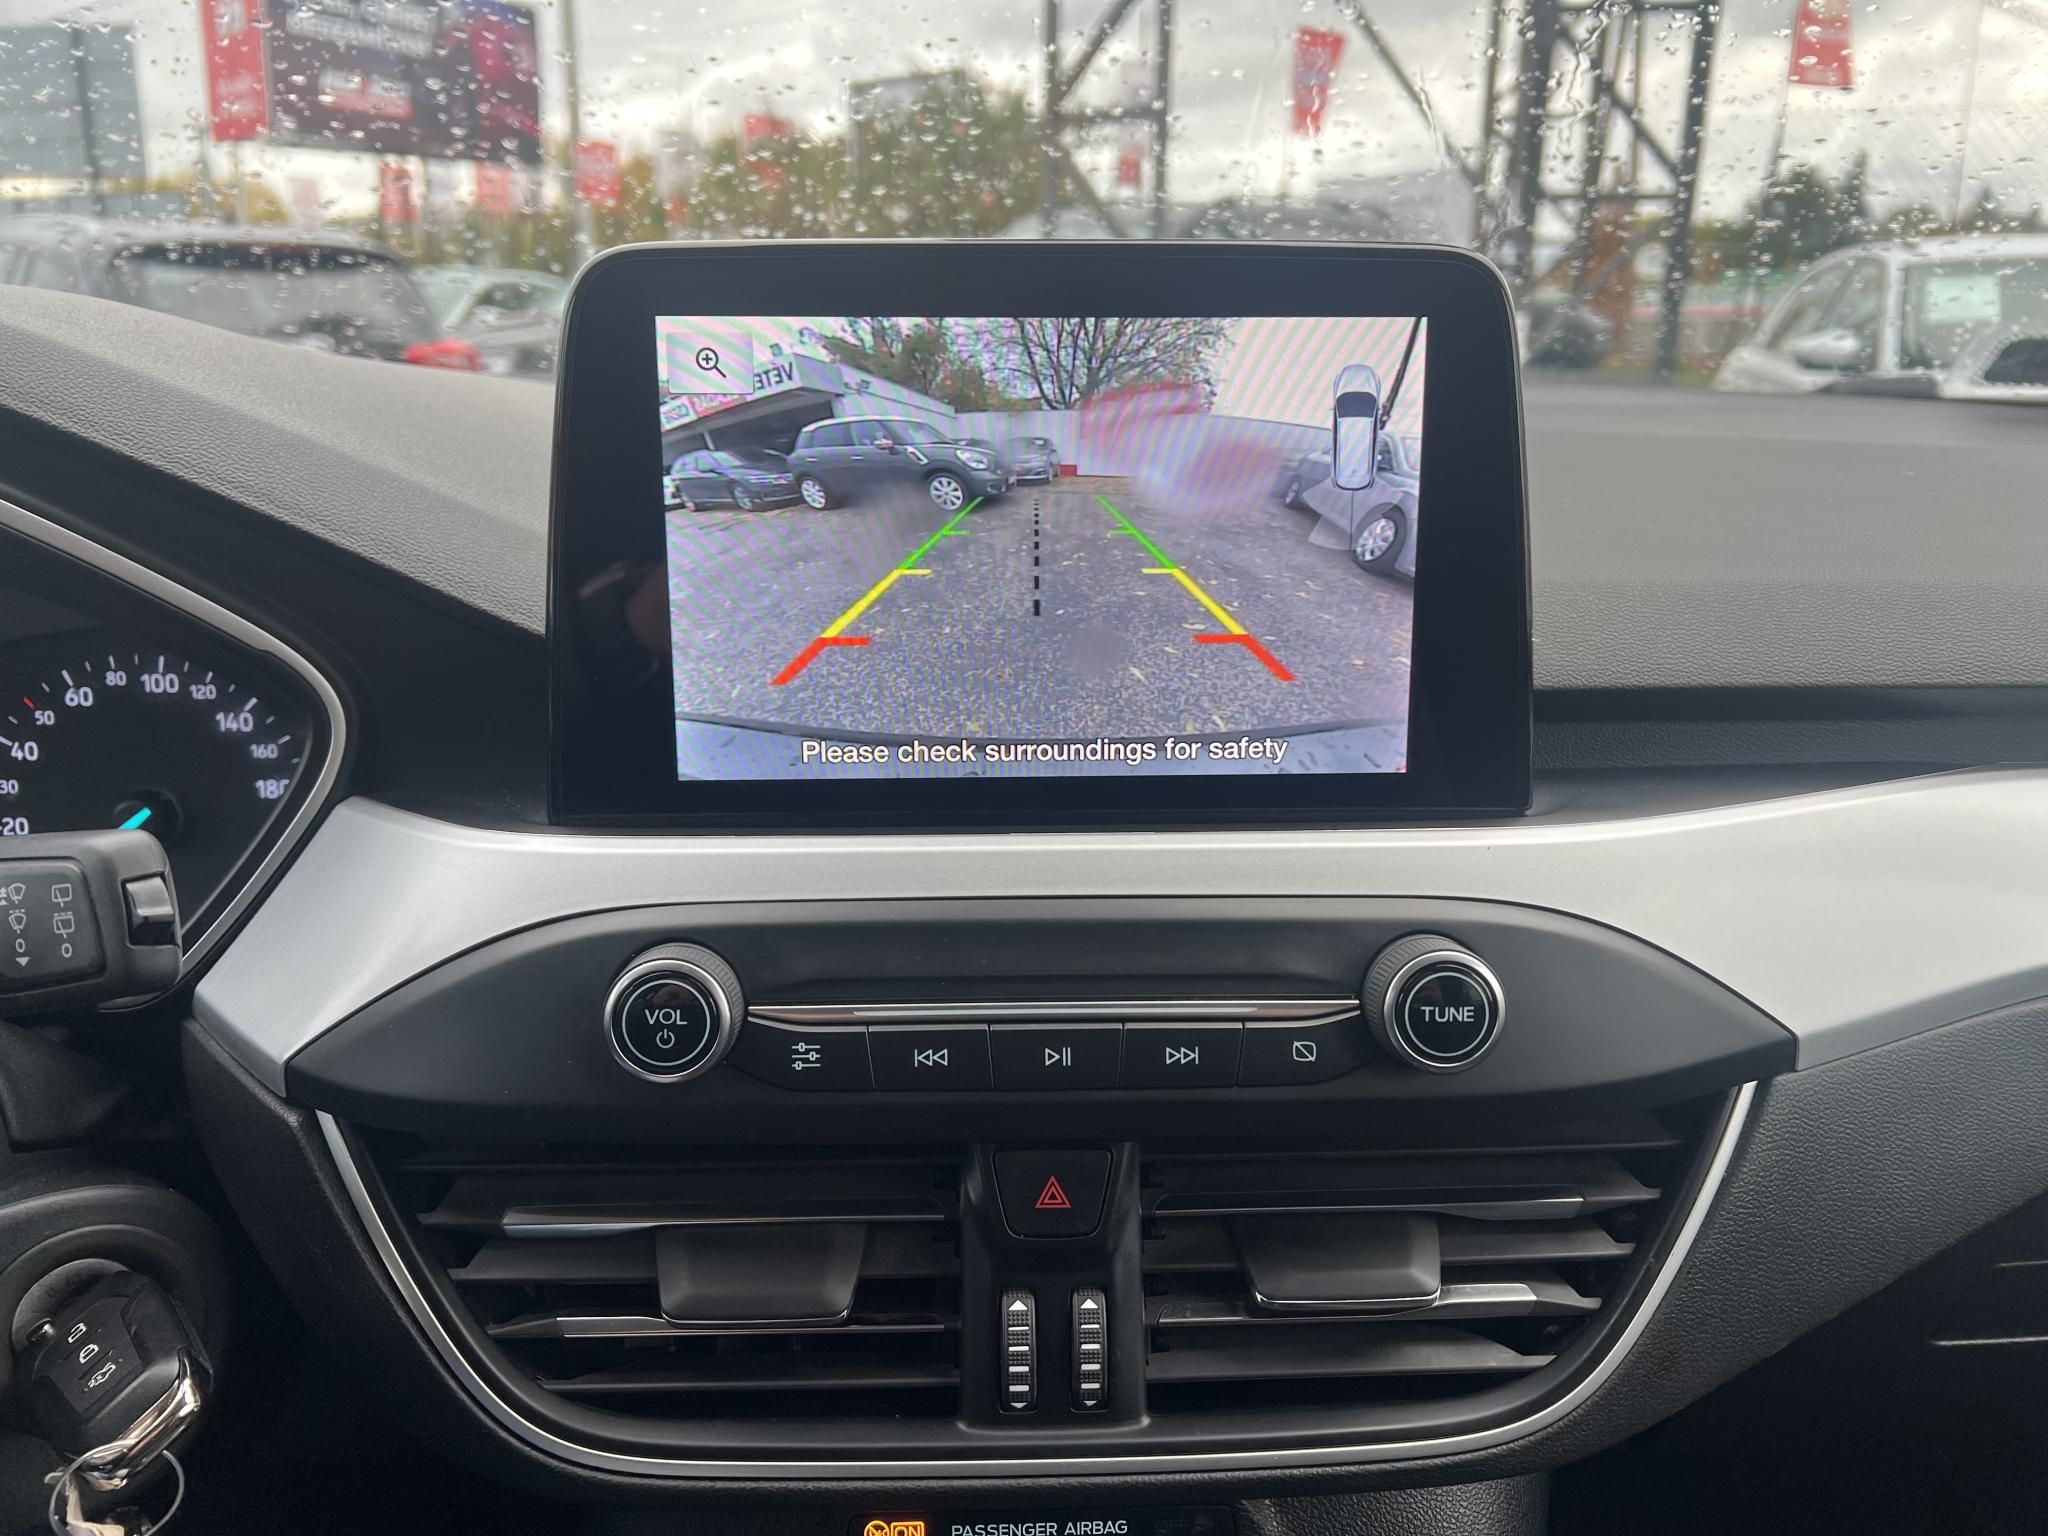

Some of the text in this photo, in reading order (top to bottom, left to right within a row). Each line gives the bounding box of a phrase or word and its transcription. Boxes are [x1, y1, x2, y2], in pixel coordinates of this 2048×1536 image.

[105, 671, 127, 686] 80
[140, 673, 179, 694] 100
[64, 686, 93, 707] 60
[189, 684, 217, 700] 120
[34, 710, 55, 725] 50
[215, 712, 254, 732] 140
[10, 741, 39, 761] 40
[250, 743, 278, 759] 160
[801, 737, 1288, 765] Please check surroundings for safety
[0, 779, 19, 794] 30
[1, 817, 29, 836] 20
[644, 1008, 688, 1025] VOL
[1420, 1006, 1475, 1022] TUNE
[894, 1525, 920, 1536] ON
[951, 1520, 1128, 1536] PASSENGER AIRBAG
